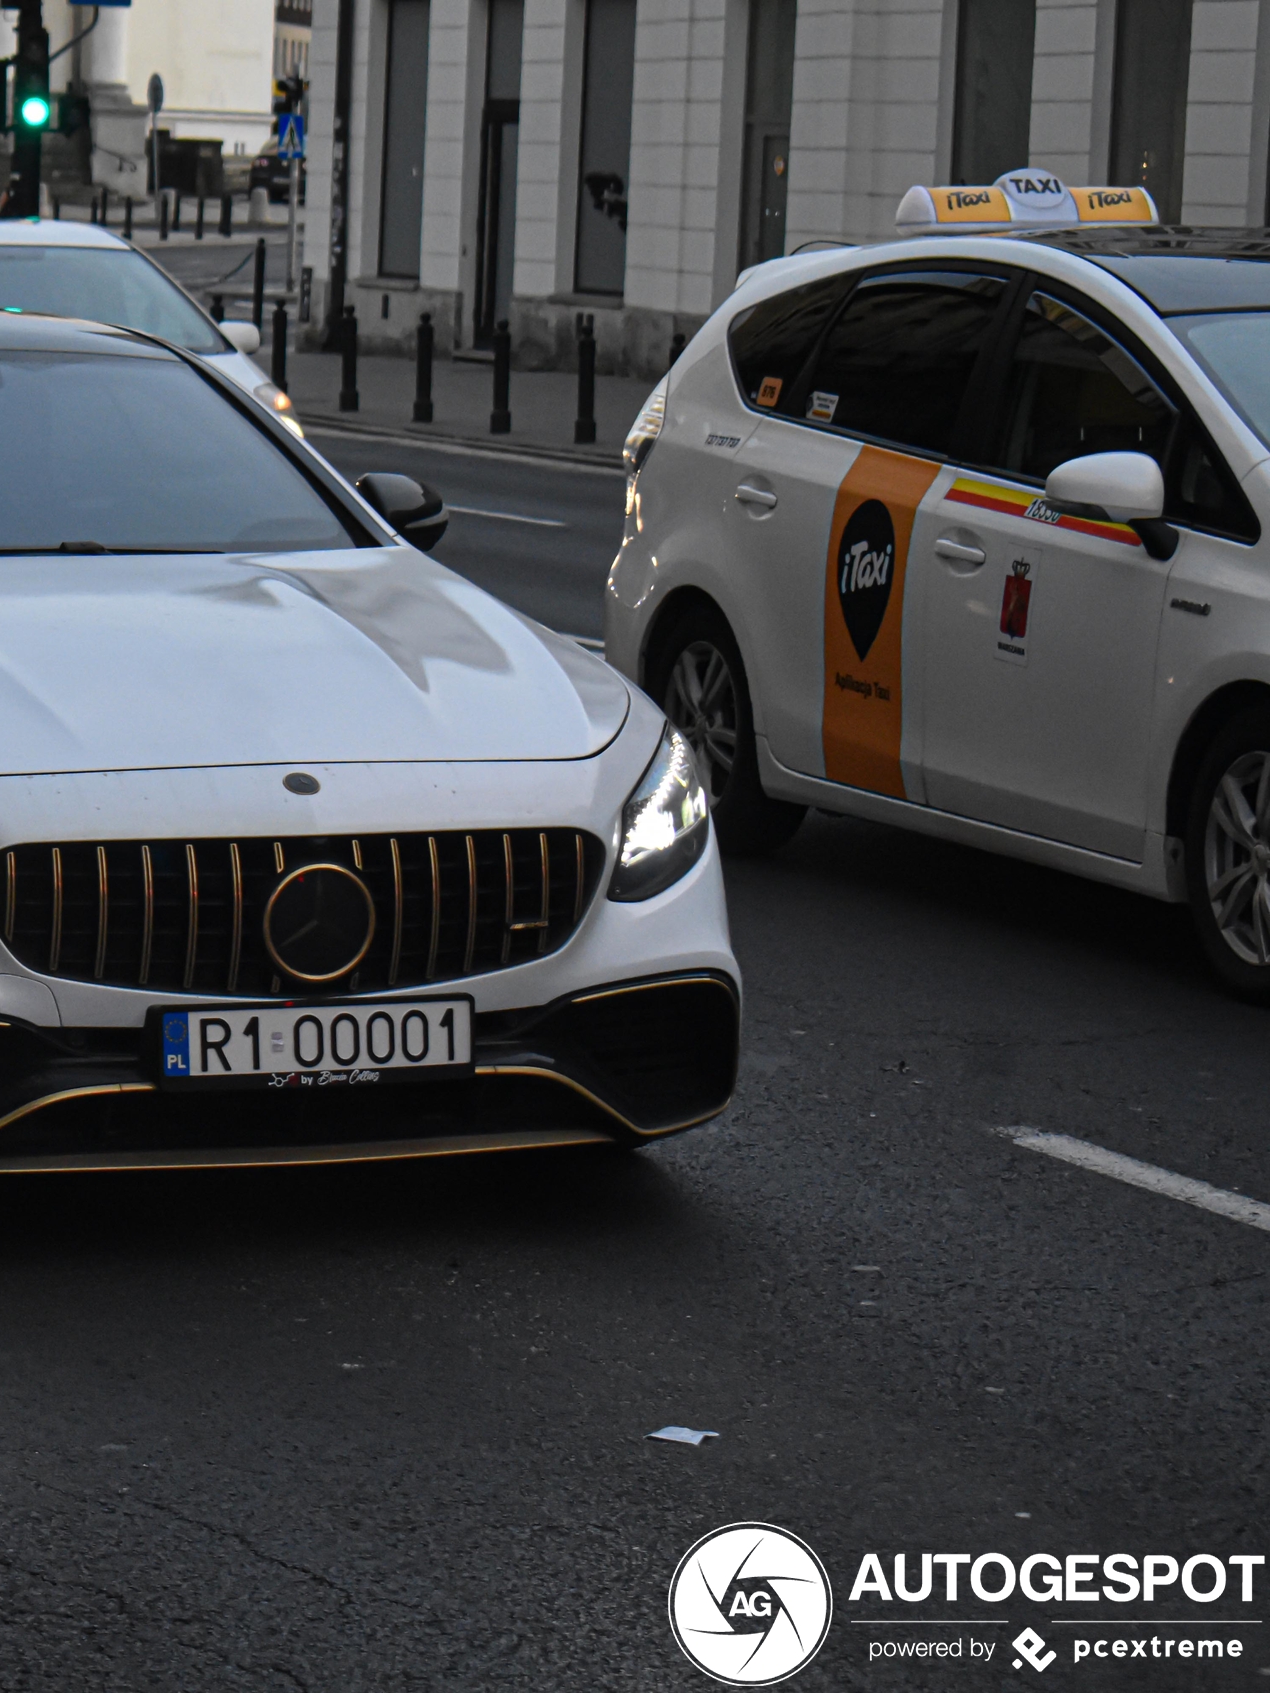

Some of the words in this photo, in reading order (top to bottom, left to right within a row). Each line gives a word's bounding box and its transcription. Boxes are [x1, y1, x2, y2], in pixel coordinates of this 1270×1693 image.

[1009, 178, 1062, 194] TAXI
[947, 190, 991, 210] iTaxi
[1088, 190, 1132, 210] iTaxi
[842, 540, 892, 594] iTaxi
[199, 1016, 261, 1072] R1
[293, 1008, 455, 1068] 00001
[167, 1054, 187, 1069] PL
[301, 1075, 314, 1086] by
